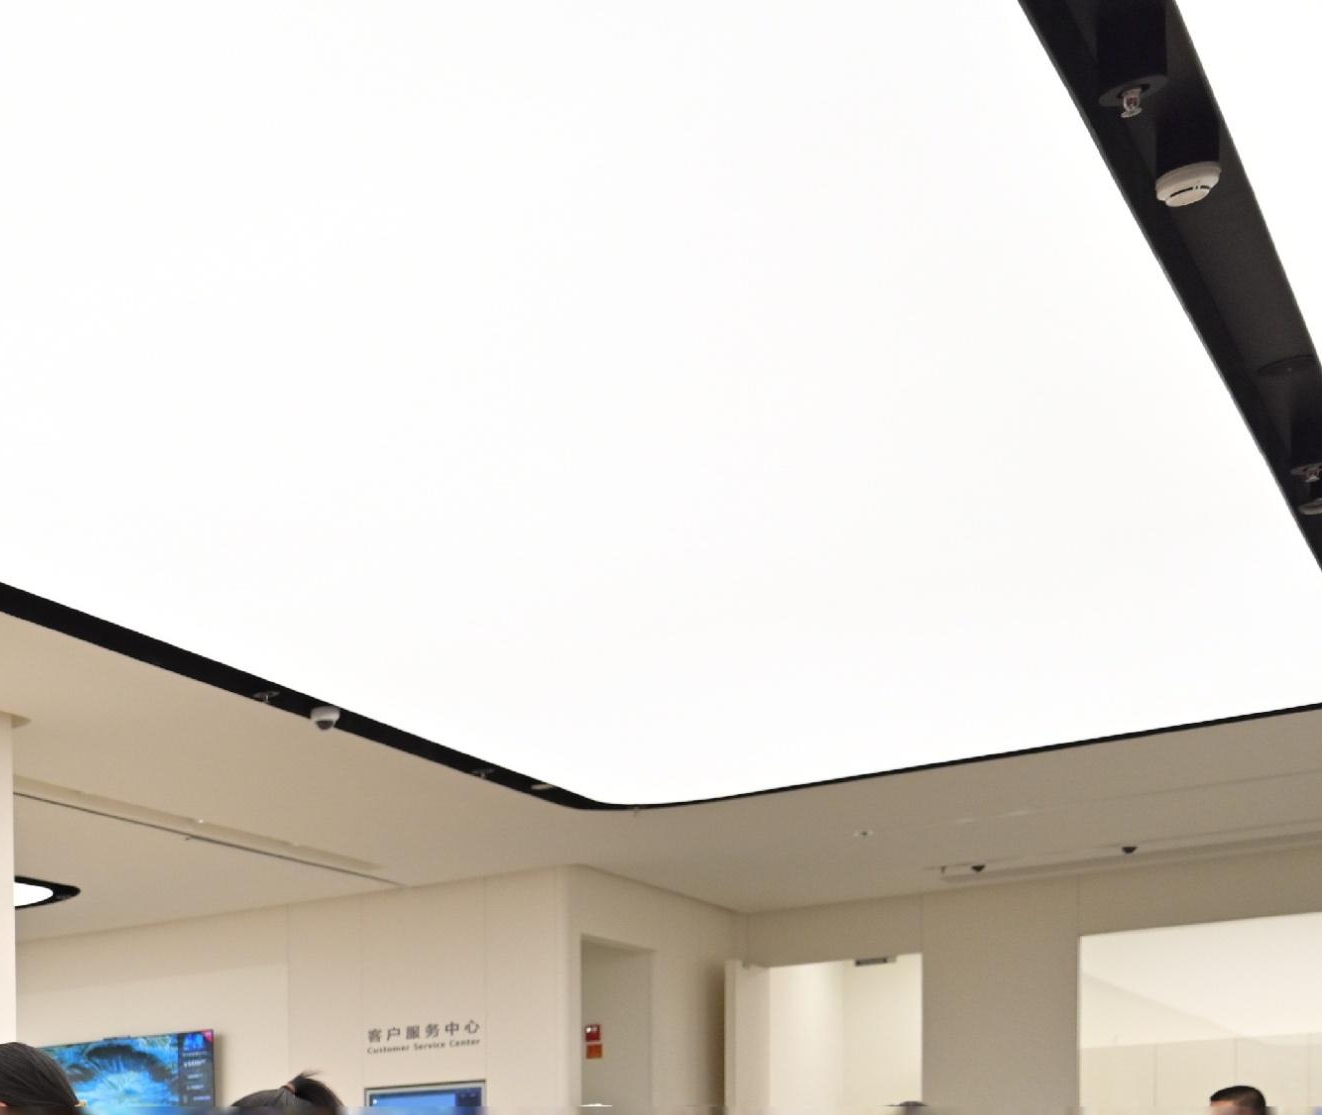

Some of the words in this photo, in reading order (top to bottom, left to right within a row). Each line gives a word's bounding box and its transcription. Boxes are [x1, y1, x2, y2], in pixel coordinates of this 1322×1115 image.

[367, 1019, 481, 1043] 客户服务中心
[367, 1045, 410, 1055] Customer
[413, 1041, 446, 1051] Service
[449, 1038, 481, 1048] Center
